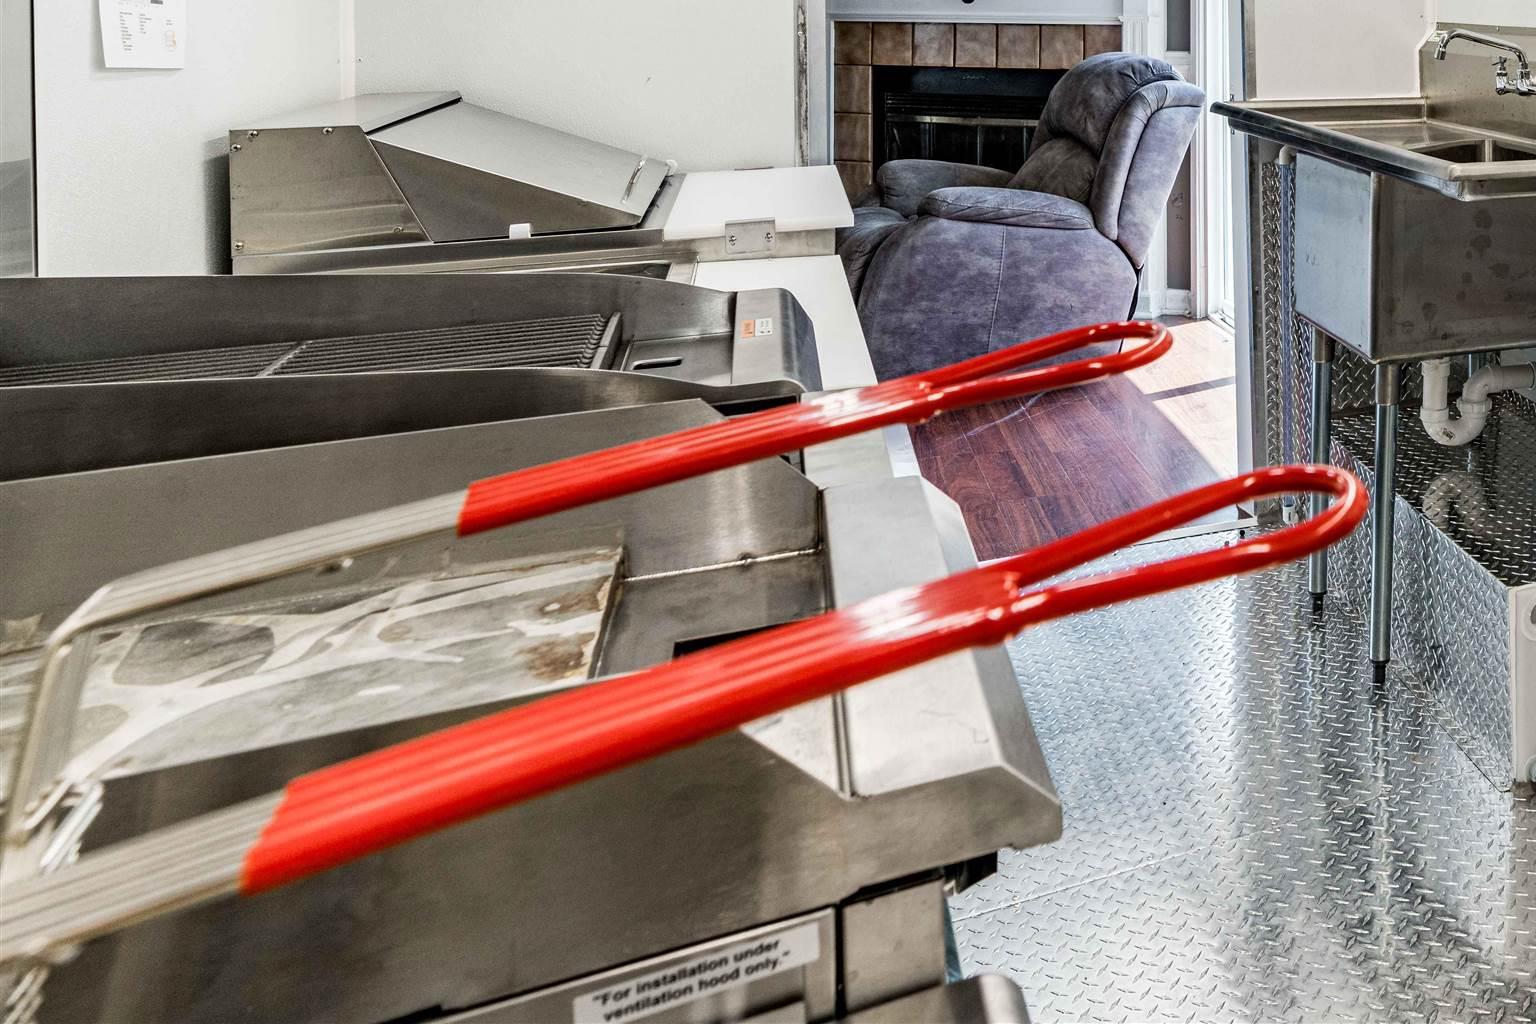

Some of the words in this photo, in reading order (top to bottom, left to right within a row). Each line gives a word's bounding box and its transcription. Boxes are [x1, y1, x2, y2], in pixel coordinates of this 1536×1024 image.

[636, 956, 729, 994] installation
[733, 939, 780, 963] under
[603, 984, 693, 1022] ventilation
[699, 969, 741, 991] hood
